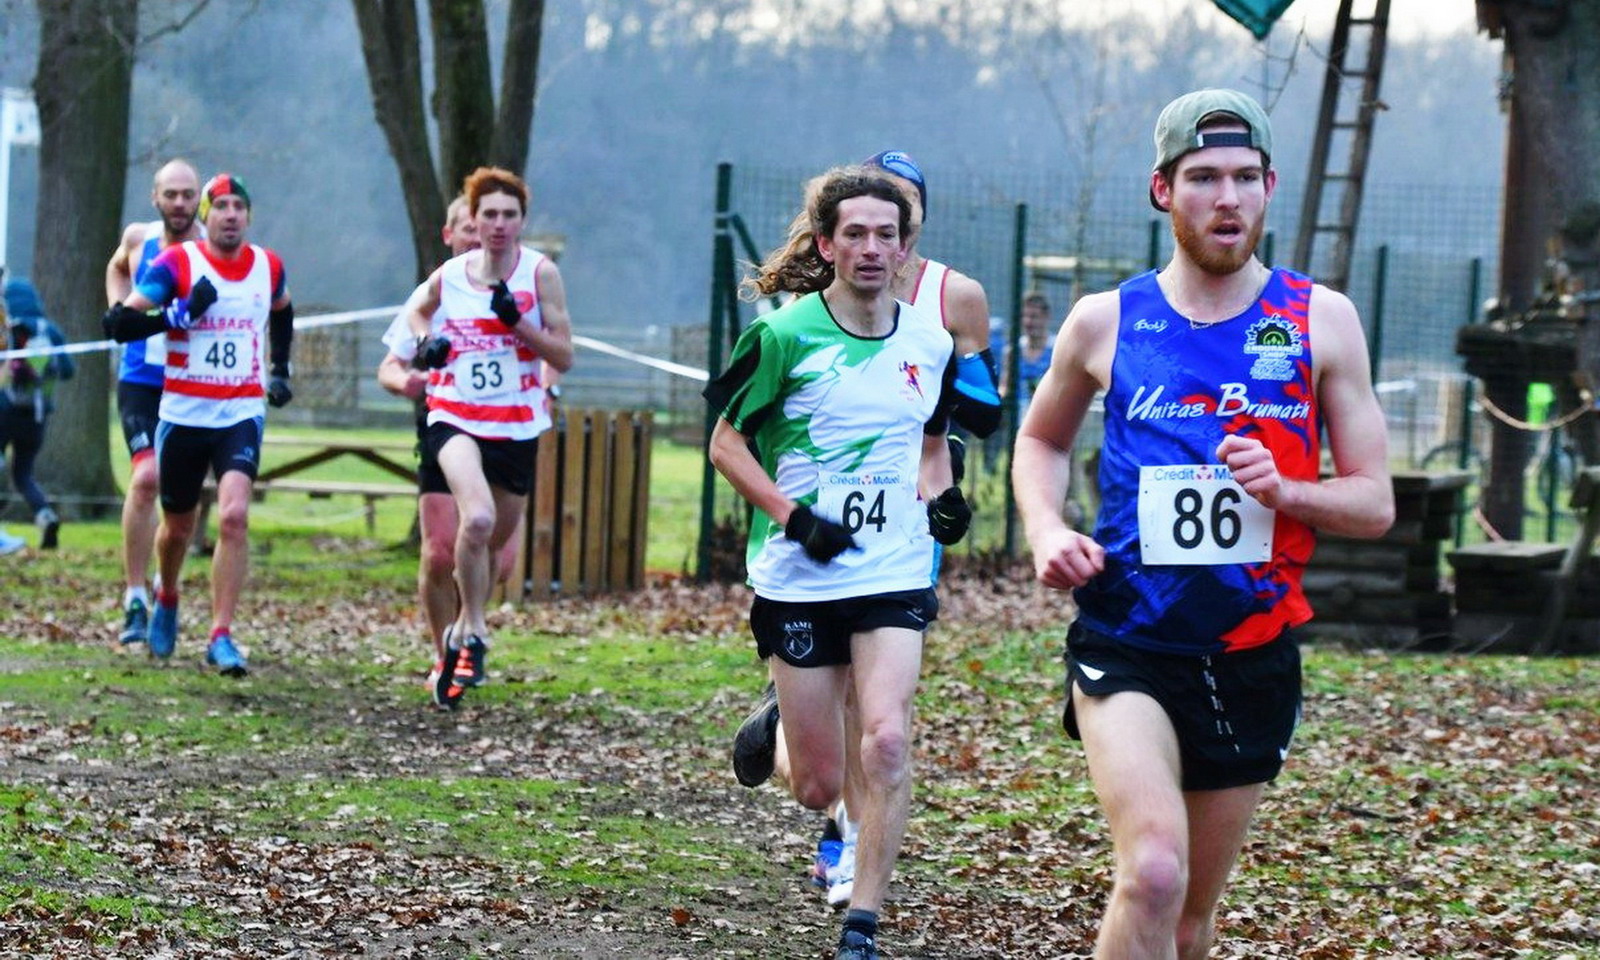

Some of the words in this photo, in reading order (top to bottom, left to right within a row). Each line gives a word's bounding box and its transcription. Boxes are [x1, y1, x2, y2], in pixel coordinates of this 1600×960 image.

[205, 342, 237, 368] 48
[471, 361, 503, 390] 53
[1126, 385, 1206, 421] Unitas
[1215, 382, 1311, 420] Brumath
[842, 490, 887, 533] 64
[1172, 488, 1242, 549] 86
